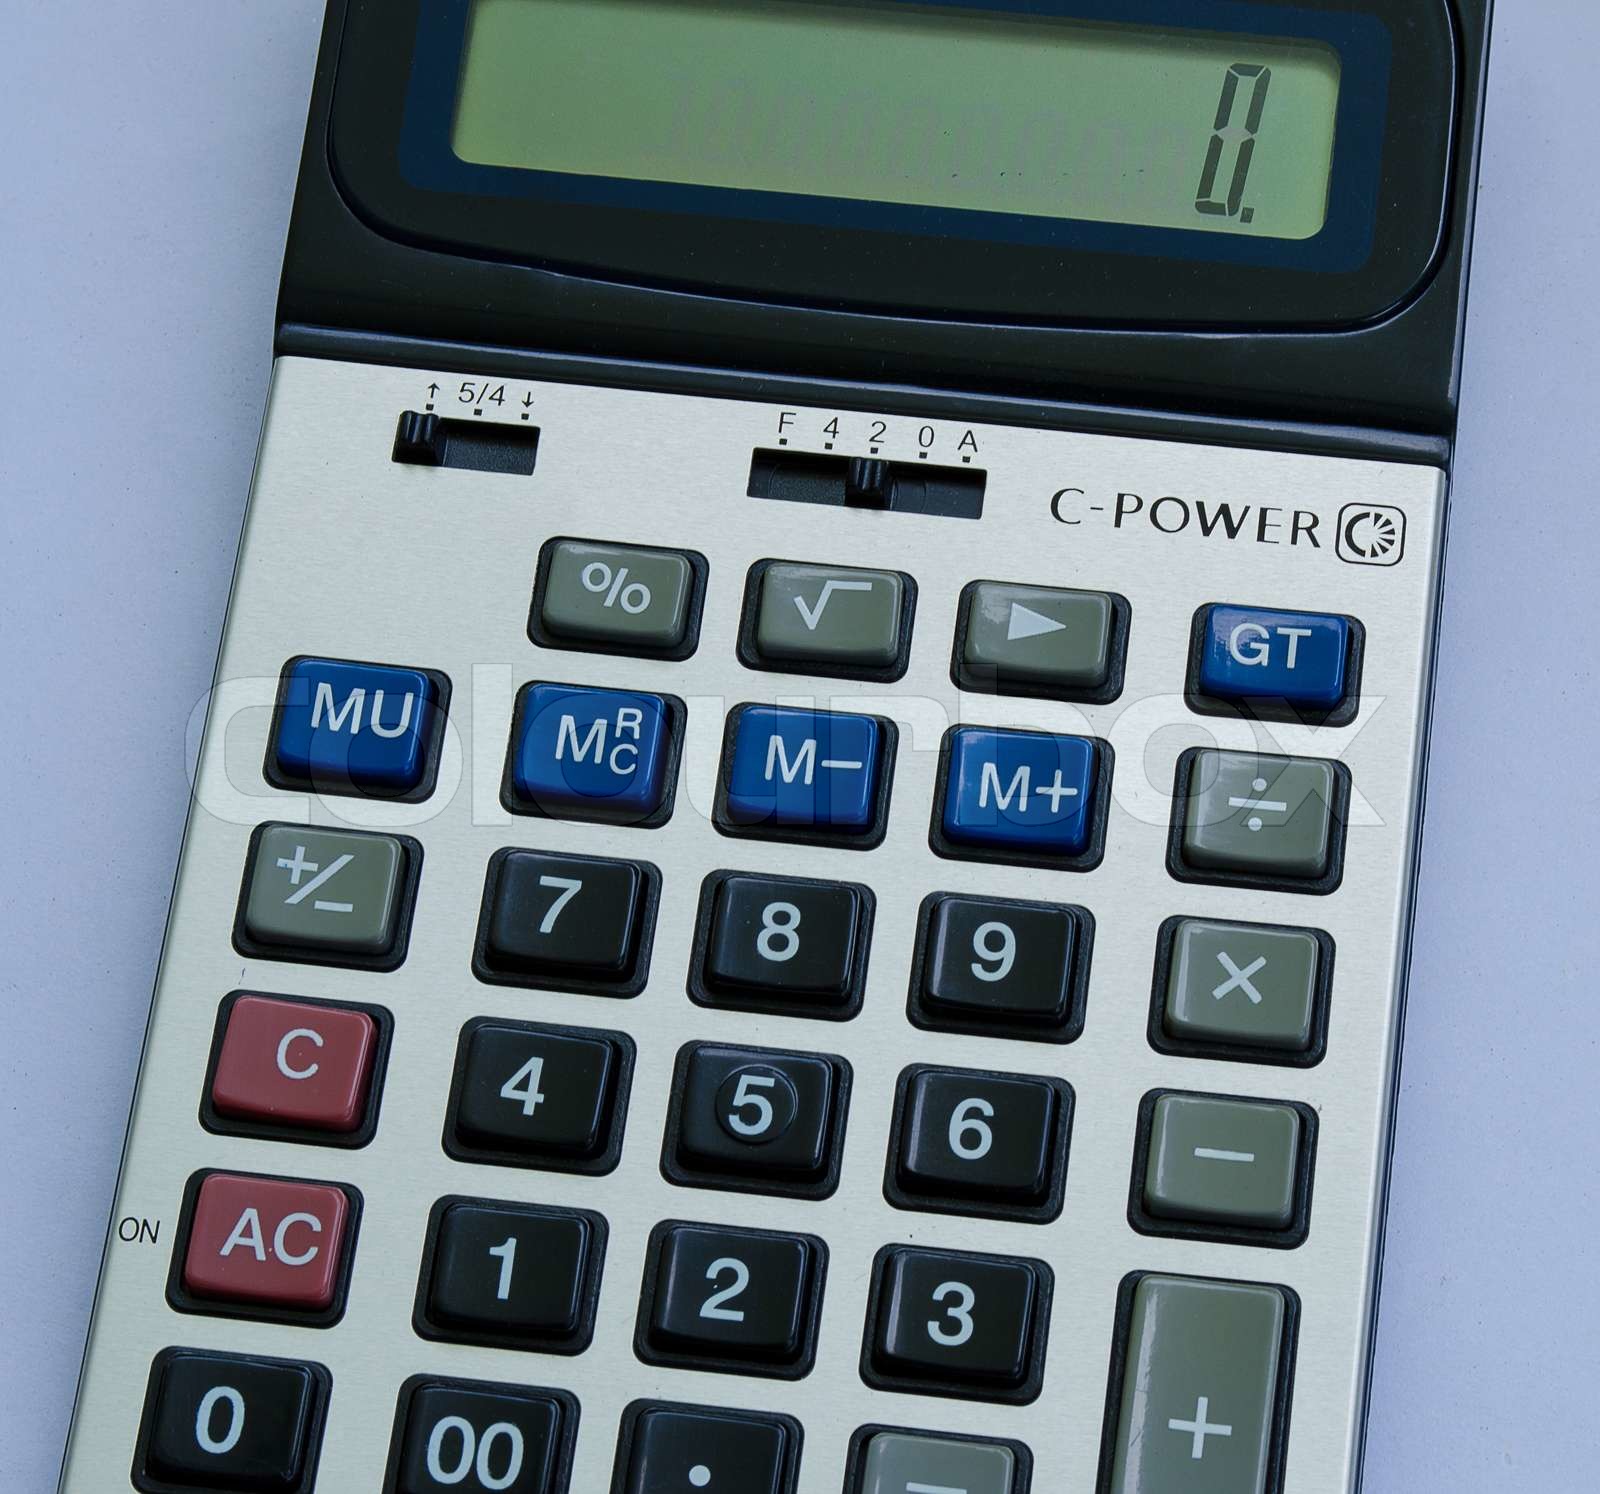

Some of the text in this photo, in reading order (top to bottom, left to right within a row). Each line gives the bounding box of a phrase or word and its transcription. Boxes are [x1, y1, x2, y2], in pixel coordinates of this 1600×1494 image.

[458, 385, 505, 406] 5/4
[778, 412, 797, 434] F
[823, 417, 840, 439] 4
[869, 421, 886, 443] 2
[957, 431, 978, 452] A
[1051, 488, 1321, 548] C-POWER
[1230, 623, 1312, 669] GT
[311, 682, 414, 739] MU
[979, 761, 1078, 814] M+
[538, 875, 582, 933] 7
[756, 902, 801, 961] 8
[971, 921, 1017, 981] 9
[276, 1028, 323, 1080] C
[500, 1056, 545, 1116] 4
[728, 1075, 776, 1136] 5
[948, 1098, 993, 1160] 6
[118, 1216, 160, 1244] ON
[220, 1208, 322, 1266] AC
[489, 1237, 517, 1300] 1
[699, 1257, 750, 1322] 2
[928, 1281, 976, 1347] 3
[195, 1386, 246, 1455] 0
[426, 1415, 524, 1491] 00
